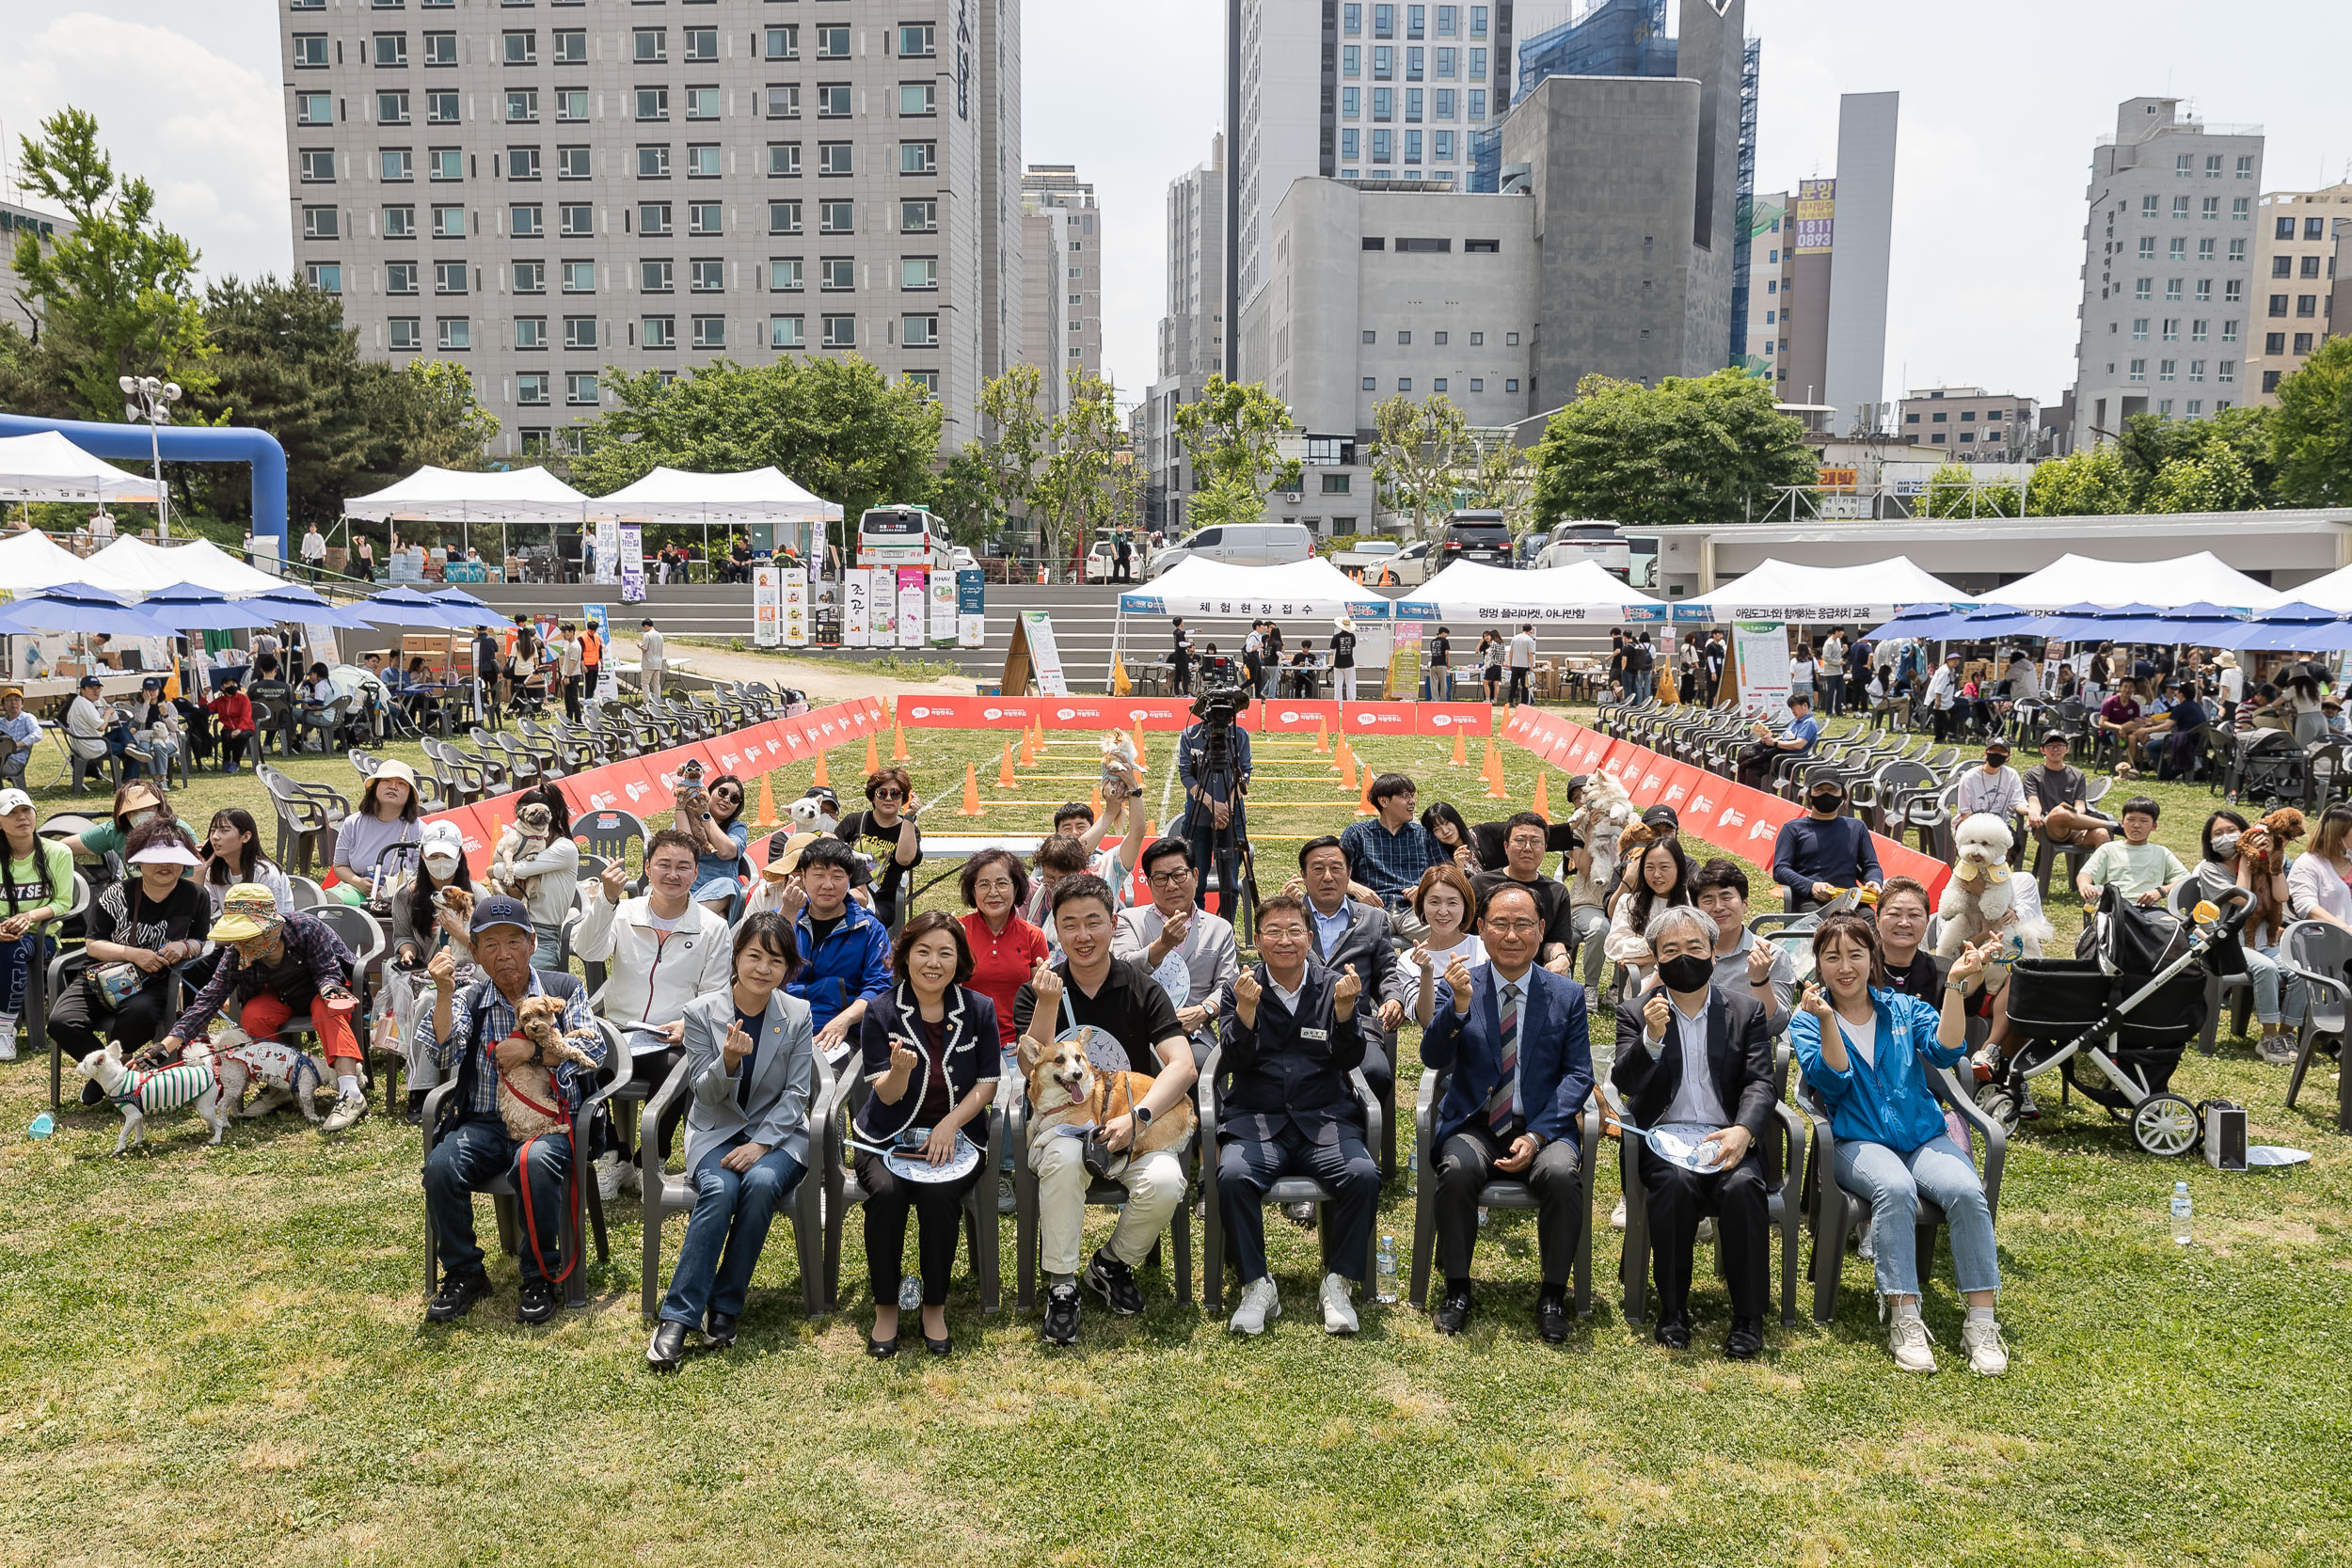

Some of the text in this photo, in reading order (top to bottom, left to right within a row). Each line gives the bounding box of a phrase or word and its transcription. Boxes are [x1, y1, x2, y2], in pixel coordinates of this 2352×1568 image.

[1801, 181, 1834, 200] 분양
[1798, 219, 1832, 233] 1811
[1797, 232, 1832, 246] 0893
[1820, 471, 1855, 485] 래방
[1478, 608, 1499, 619] 멍멍
[1736, 607, 1870, 620] 아임도그너와 함께하는 응급처치 교육
[490, 903, 512, 915] EDS
